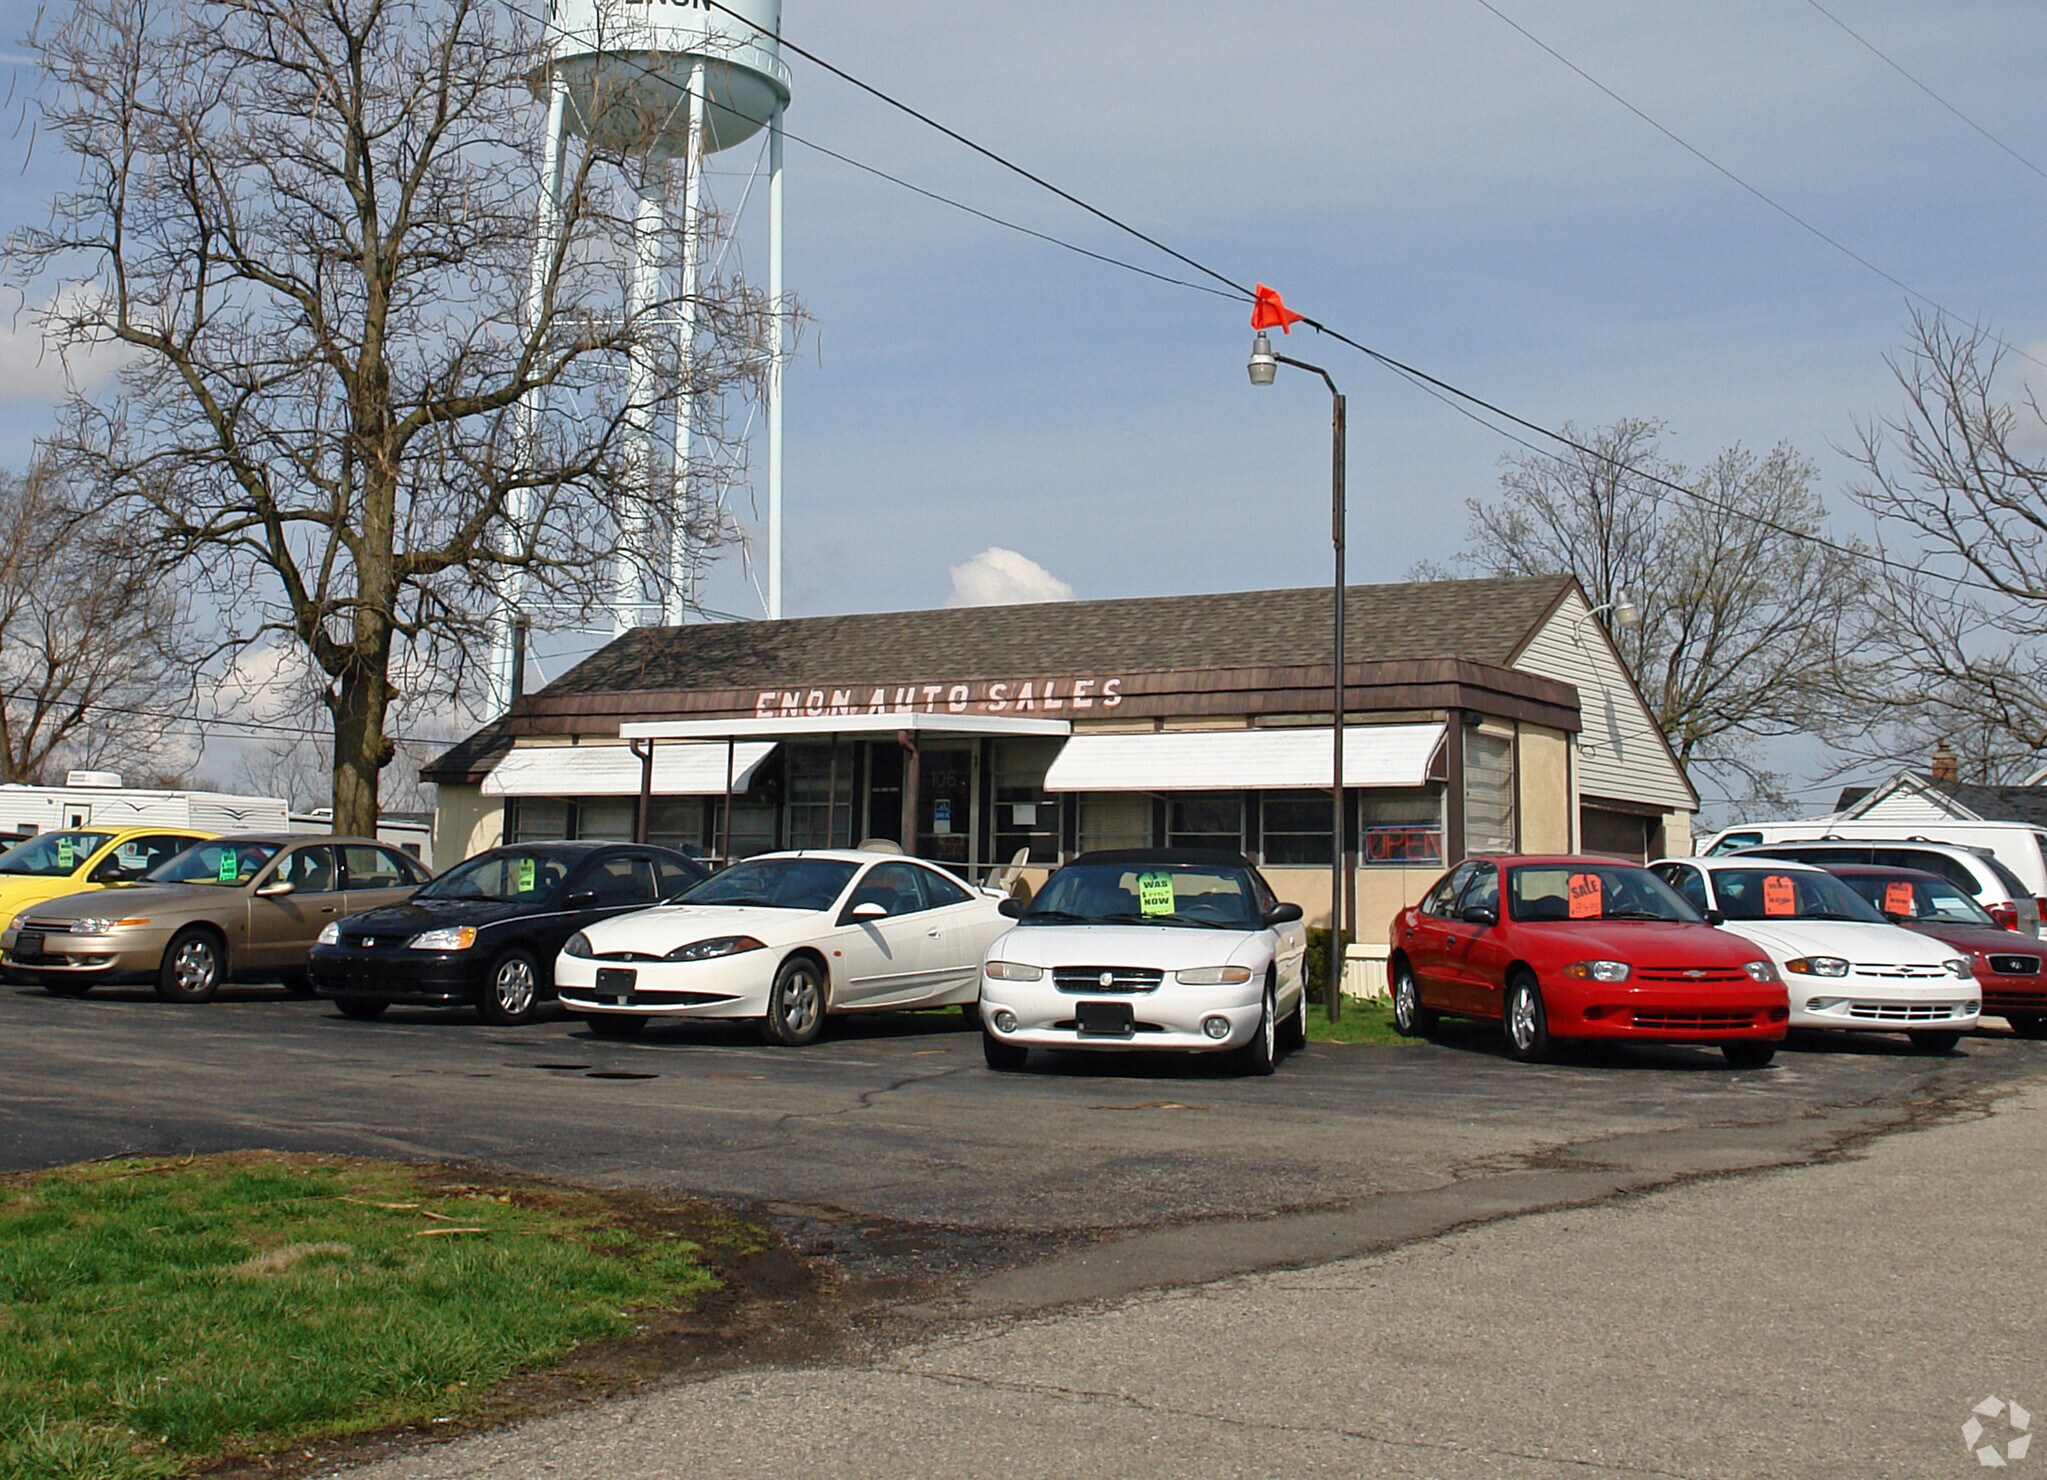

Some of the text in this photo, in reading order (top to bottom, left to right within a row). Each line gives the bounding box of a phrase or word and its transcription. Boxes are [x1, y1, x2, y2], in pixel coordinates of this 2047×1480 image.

[755, 679, 1123, 718] ENON AUTO SALES
[930, 770, 957, 788] 106
[1368, 828, 1442, 859] OPEN
[1143, 880, 1168, 888] WAS
[1571, 880, 1599, 899] SALE
[1144, 897, 1169, 905] NOW
